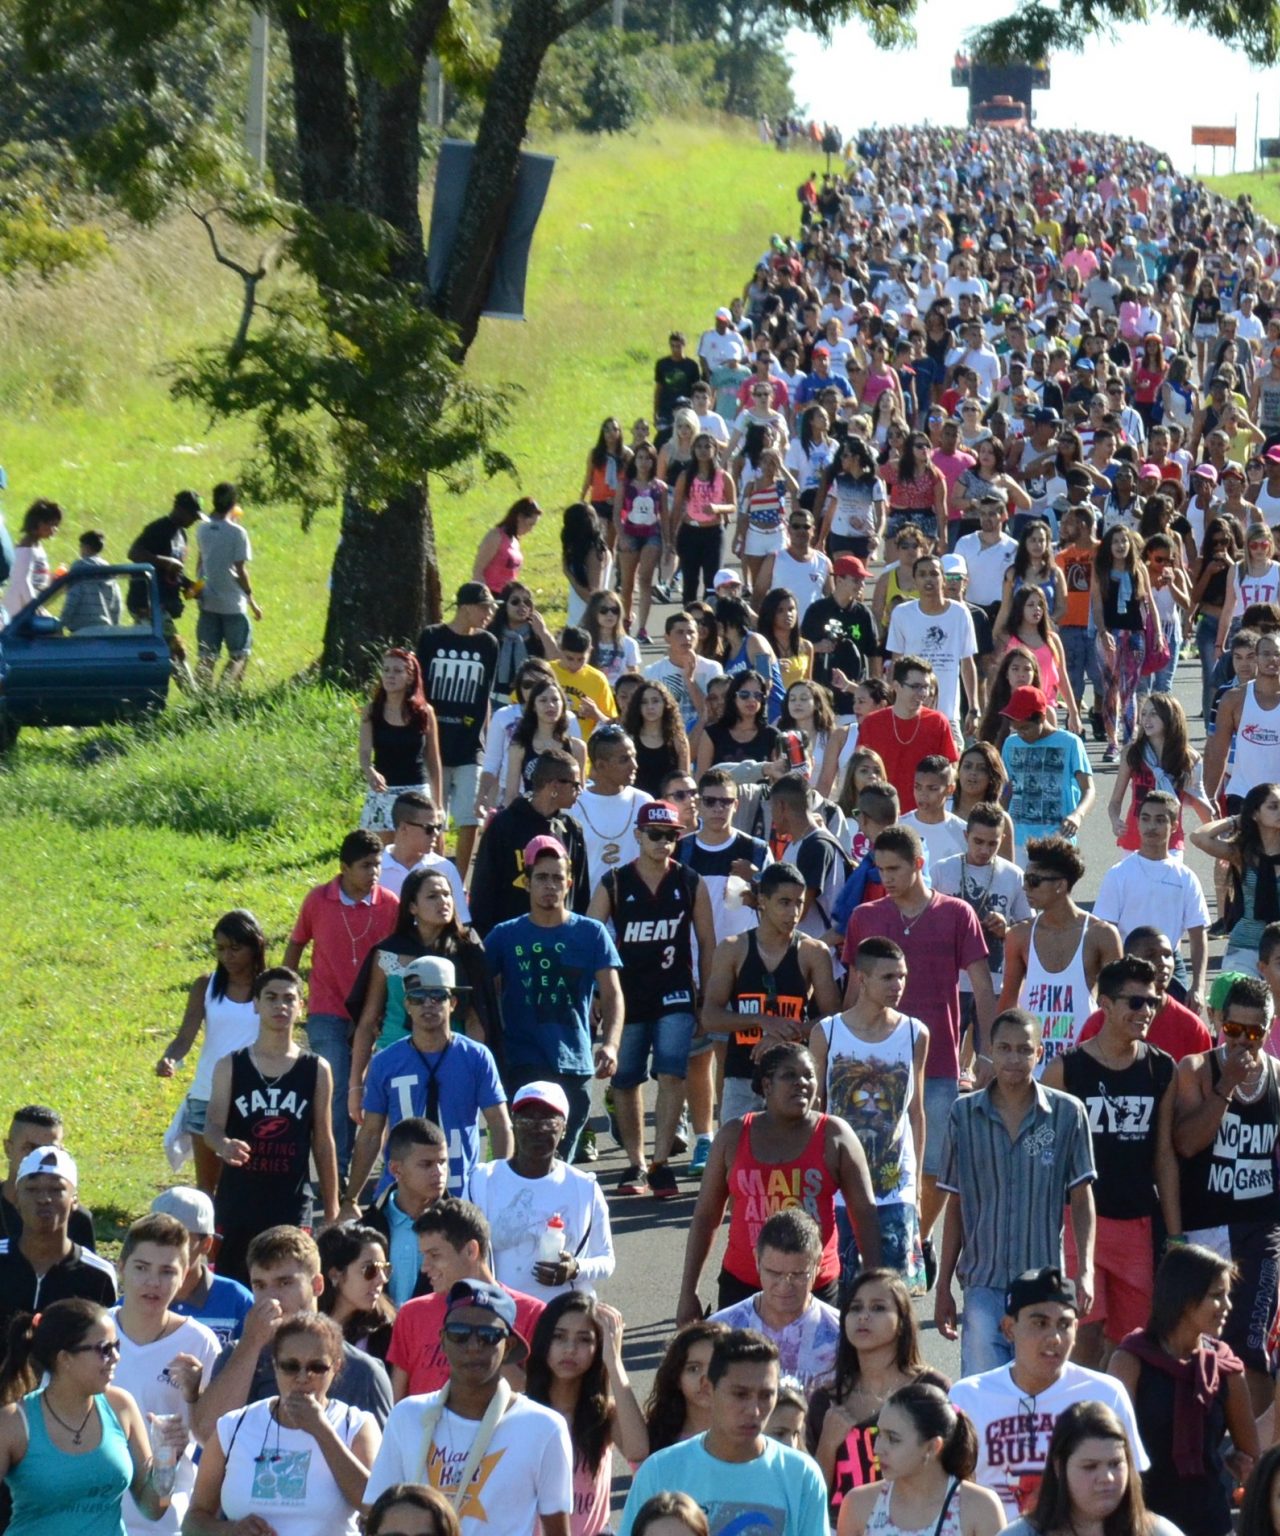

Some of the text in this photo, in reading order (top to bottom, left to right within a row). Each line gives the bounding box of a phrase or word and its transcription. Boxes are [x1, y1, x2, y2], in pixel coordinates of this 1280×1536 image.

[1241, 584, 1275, 609] FIT
[624, 911, 685, 942] HEAT
[661, 945, 676, 970] 3
[739, 999, 759, 1014] NO
[1029, 984, 1074, 1013] #FIKA
[1037, 1014, 1075, 1040] ANDE
[235, 1087, 308, 1119] FATAL
[1086, 1096, 1155, 1133] ZYZZ
[1216, 1120, 1279, 1154] NO PAIN
[736, 1167, 823, 1197] MAIS
[1207, 1163, 1272, 1193] NO GAIN
[985, 1412, 1057, 1446] CHICA
[987, 1437, 1051, 1466] BUL
